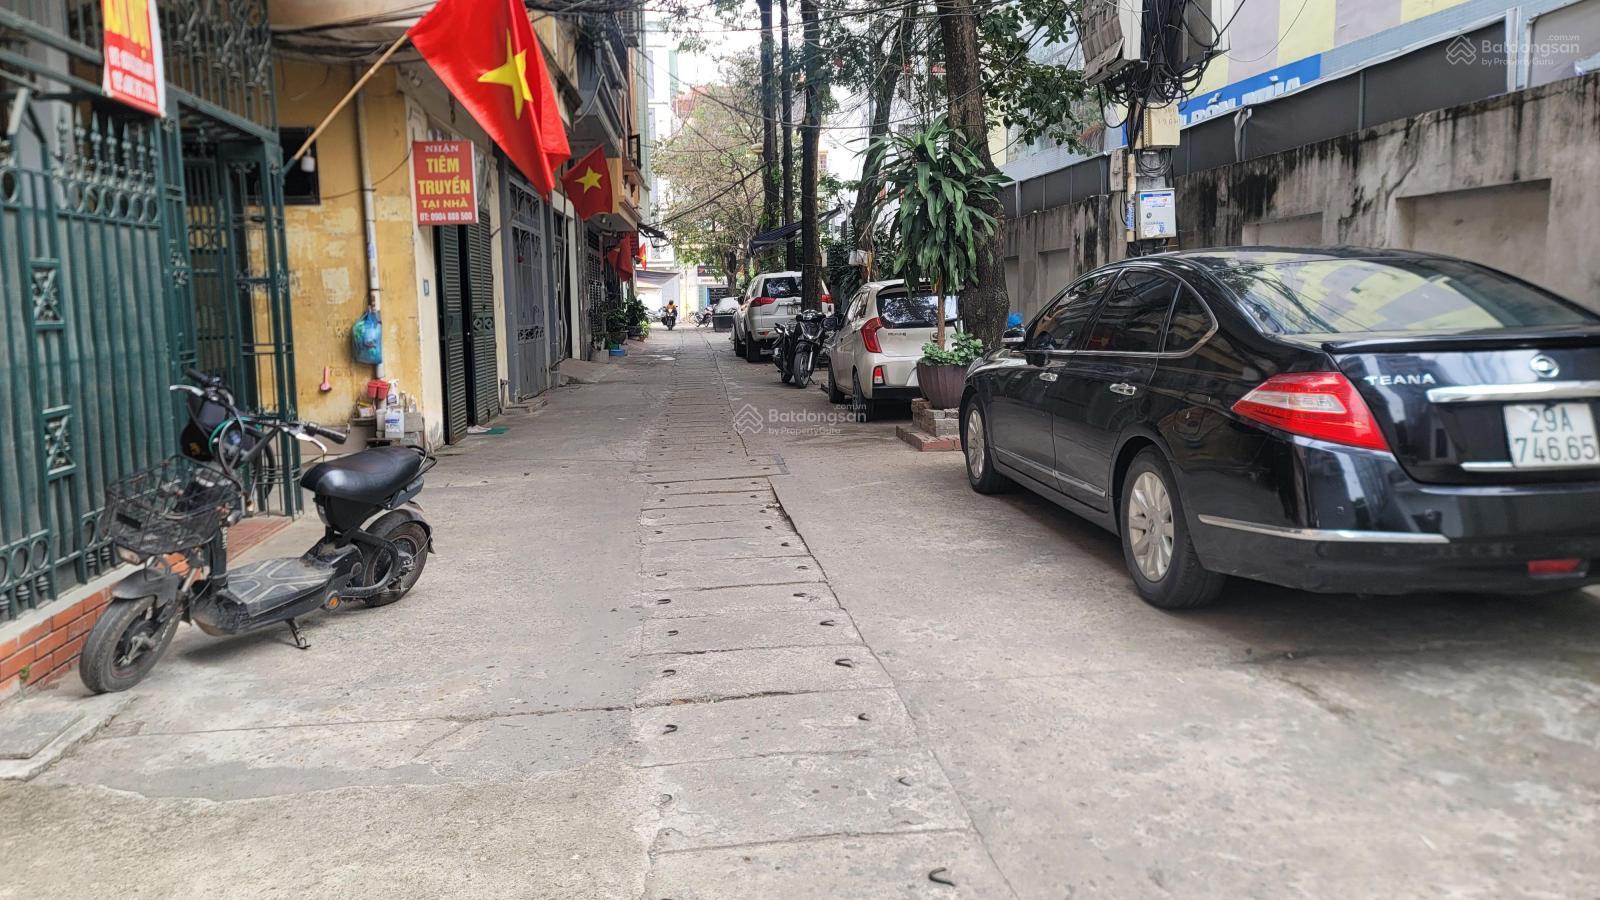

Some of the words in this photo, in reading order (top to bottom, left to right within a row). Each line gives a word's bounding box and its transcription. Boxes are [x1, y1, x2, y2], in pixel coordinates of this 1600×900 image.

[425, 144, 459, 154] NHẬN
[426, 155, 460, 173] TIÊM
[421, 199, 440, 210] TẠI
[443, 197, 468, 208] NHÀ
[1364, 373, 1436, 386] TEANA
[1530, 407, 1573, 433] 29A
[1514, 435, 1597, 463] 746.65
